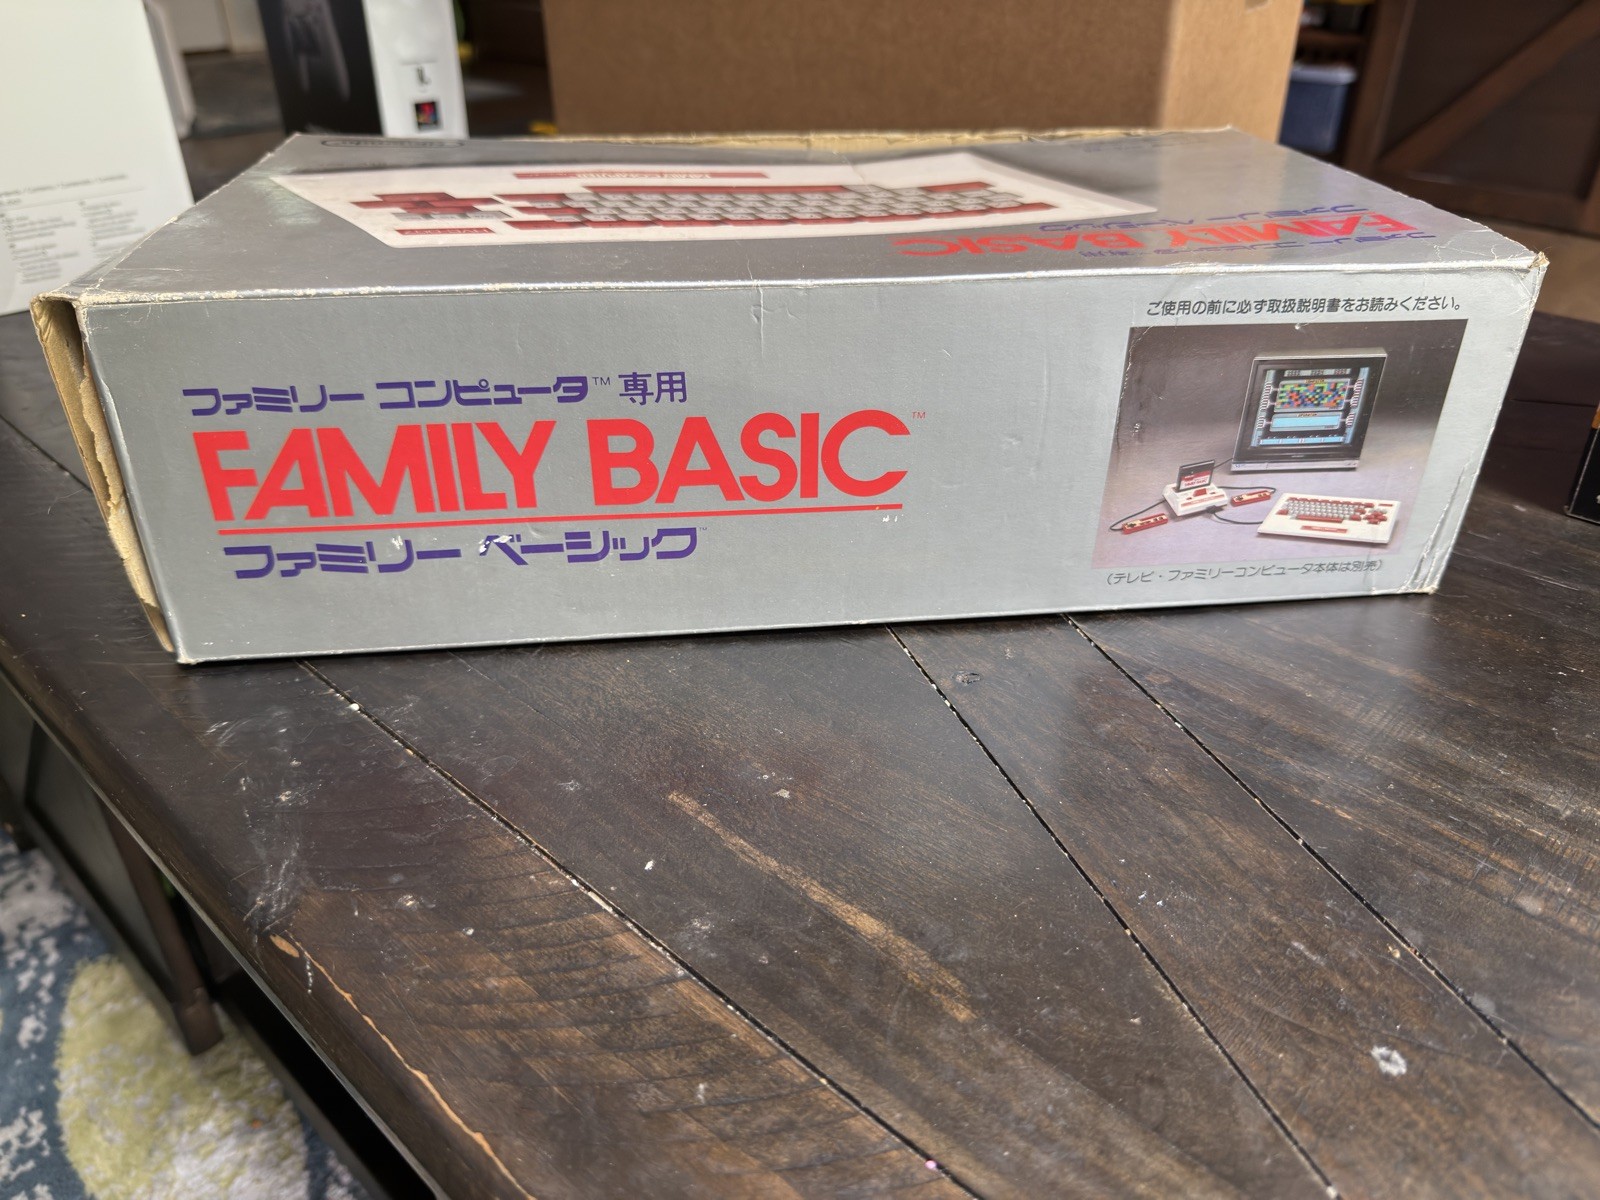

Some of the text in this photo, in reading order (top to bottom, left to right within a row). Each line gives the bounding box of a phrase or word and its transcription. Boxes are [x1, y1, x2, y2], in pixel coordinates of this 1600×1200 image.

[892, 214, 1417, 256] FAMILY BASIC
[1146, 296, 1460, 316] ご使用の前に必ず取扱説明書をお読みください。
[182, 384, 365, 416] ファミリー
[618, 371, 688, 406] 専用
[193, 420, 557, 522] FAMILY
[586, 409, 911, 506] BASIC
[223, 539, 462, 579] ファミリー
